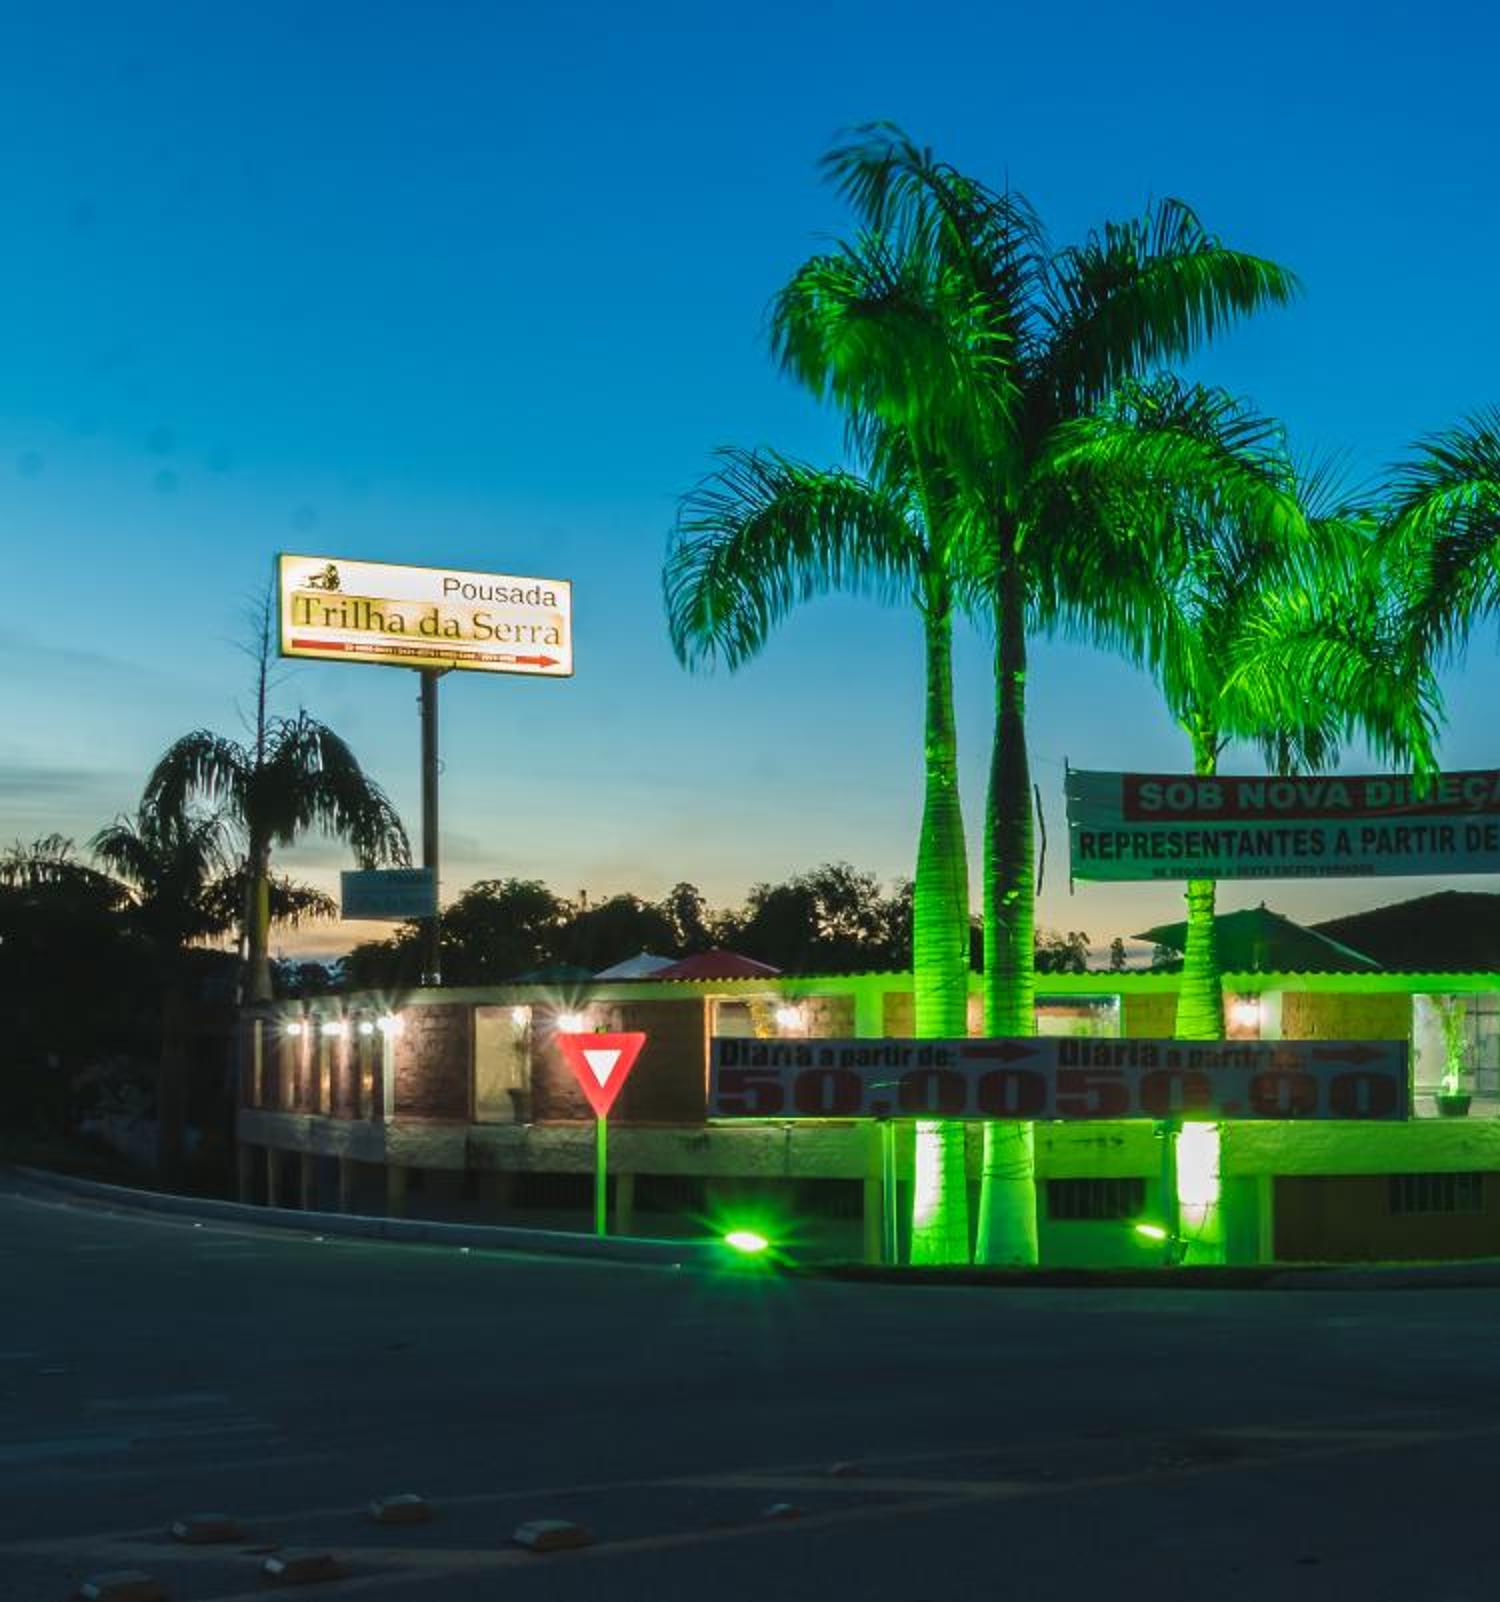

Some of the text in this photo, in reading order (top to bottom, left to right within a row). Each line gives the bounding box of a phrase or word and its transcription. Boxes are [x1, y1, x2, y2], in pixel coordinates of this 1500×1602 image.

[442, 577, 557, 608] Pousada
[294, 596, 561, 645] Trilha da Serra
[1138, 782, 1225, 812] SOB
[1236, 780, 1353, 811] NOVA
[1079, 829, 1327, 860] REPRESENTANTES
[1337, 829, 1353, 855] A
[1360, 826, 1455, 855] PARTIR
[1465, 824, 1500, 852] DE
[818, 1047, 833, 1066] a
[840, 1044, 912, 1069] partir
